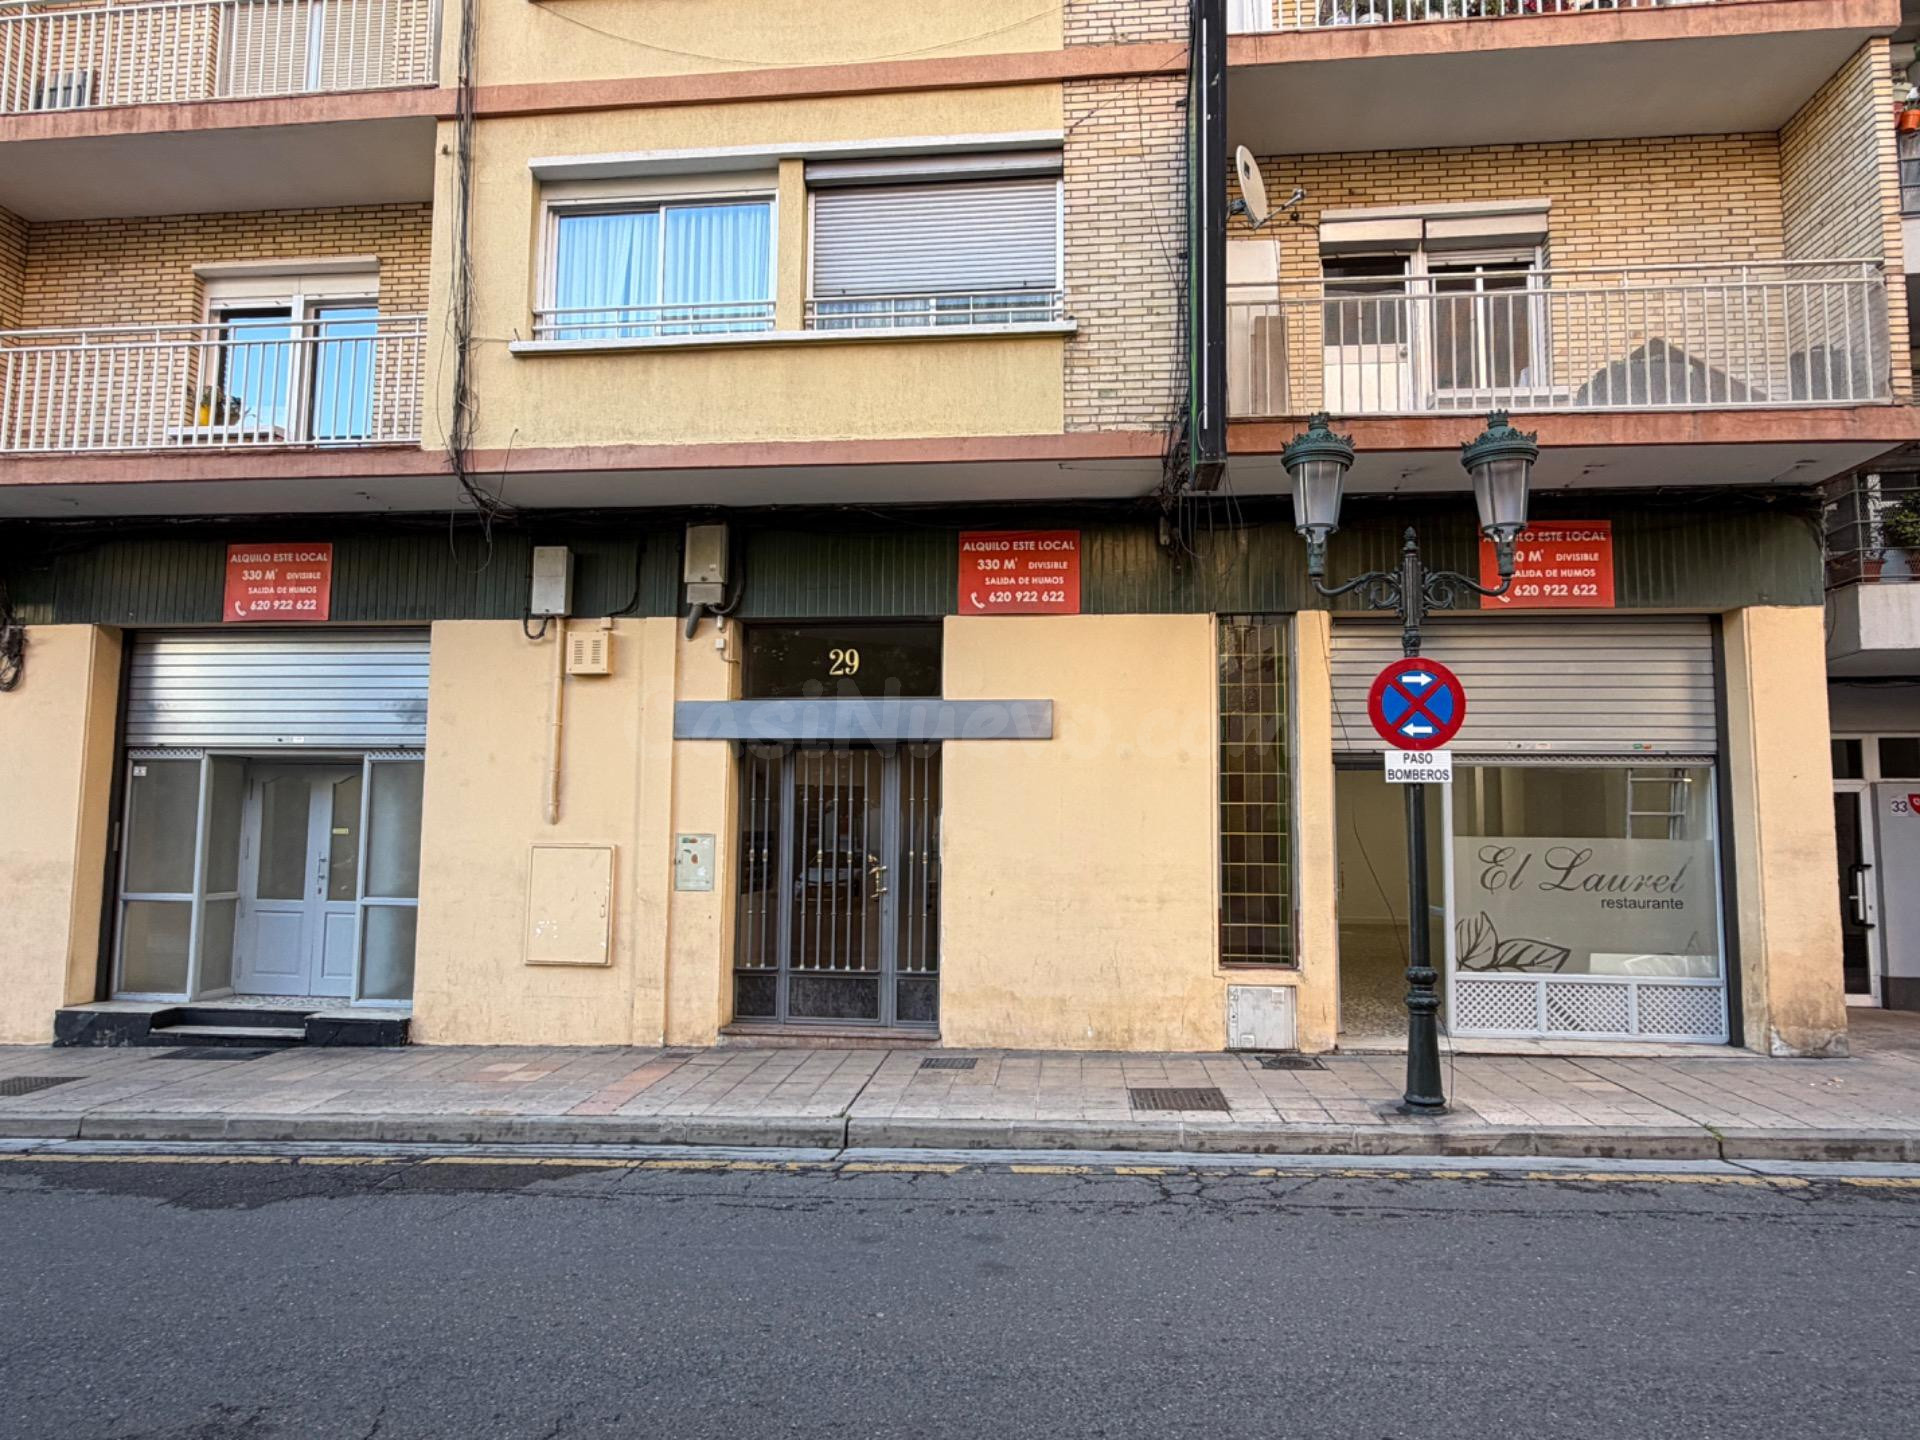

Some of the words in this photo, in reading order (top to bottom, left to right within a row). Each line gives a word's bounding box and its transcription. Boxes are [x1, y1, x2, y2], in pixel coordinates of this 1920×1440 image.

[1538, 531, 1563, 541] ESTE
[1566, 530, 1606, 541] LOCAL
[963, 542, 1010, 552] ALQUILO
[1013, 541, 1036, 551] ESTE
[1038, 540, 1075, 550] LOCAL
[231, 554, 271, 563] ALQUILO
[273, 553, 295, 562] ESTE
[295, 552, 328, 562] LOCAL
[1555, 552, 1600, 562] DIVISIBLE
[977, 559, 1000, 570] 330
[1028, 561, 1068, 570] DIVISIBLE
[242, 570, 262, 581] 330
[285, 571, 321, 580] DIVISIBLE
[1510, 569, 1543, 578] ALIDA
[1545, 569, 1558, 578] DE
[1560, 568, 1596, 578] HUMOS
[985, 577, 1016, 586] SALIDA
[1018, 577, 1030, 585] DE
[1032, 577, 1064, 585] HUMOS
[248, 586, 275, 595] SALIDA
[276, 586, 287, 594] DE
[288, 586, 317, 594] HUMOS
[1514, 585, 1539, 596] 620
[1543, 585, 1568, 596] 922
[1572, 584, 1598, 596] 622
[989, 592, 1012, 603] 620
[1015, 591, 1038, 603] 922
[1041, 591, 1065, 602] 622
[250, 601, 271, 611] 620
[273, 600, 293, 610] 922
[296, 600, 317, 610] 622
[829, 648, 860, 675] 29
[1403, 752, 1433, 764] PASO
[1387, 768, 1450, 781] BOMBEROS
[1891, 800, 1908, 813] 33
[1478, 845, 1532, 894] El
[1538, 846, 1693, 893] Laurel
[1601, 898, 1684, 910] restaurante
